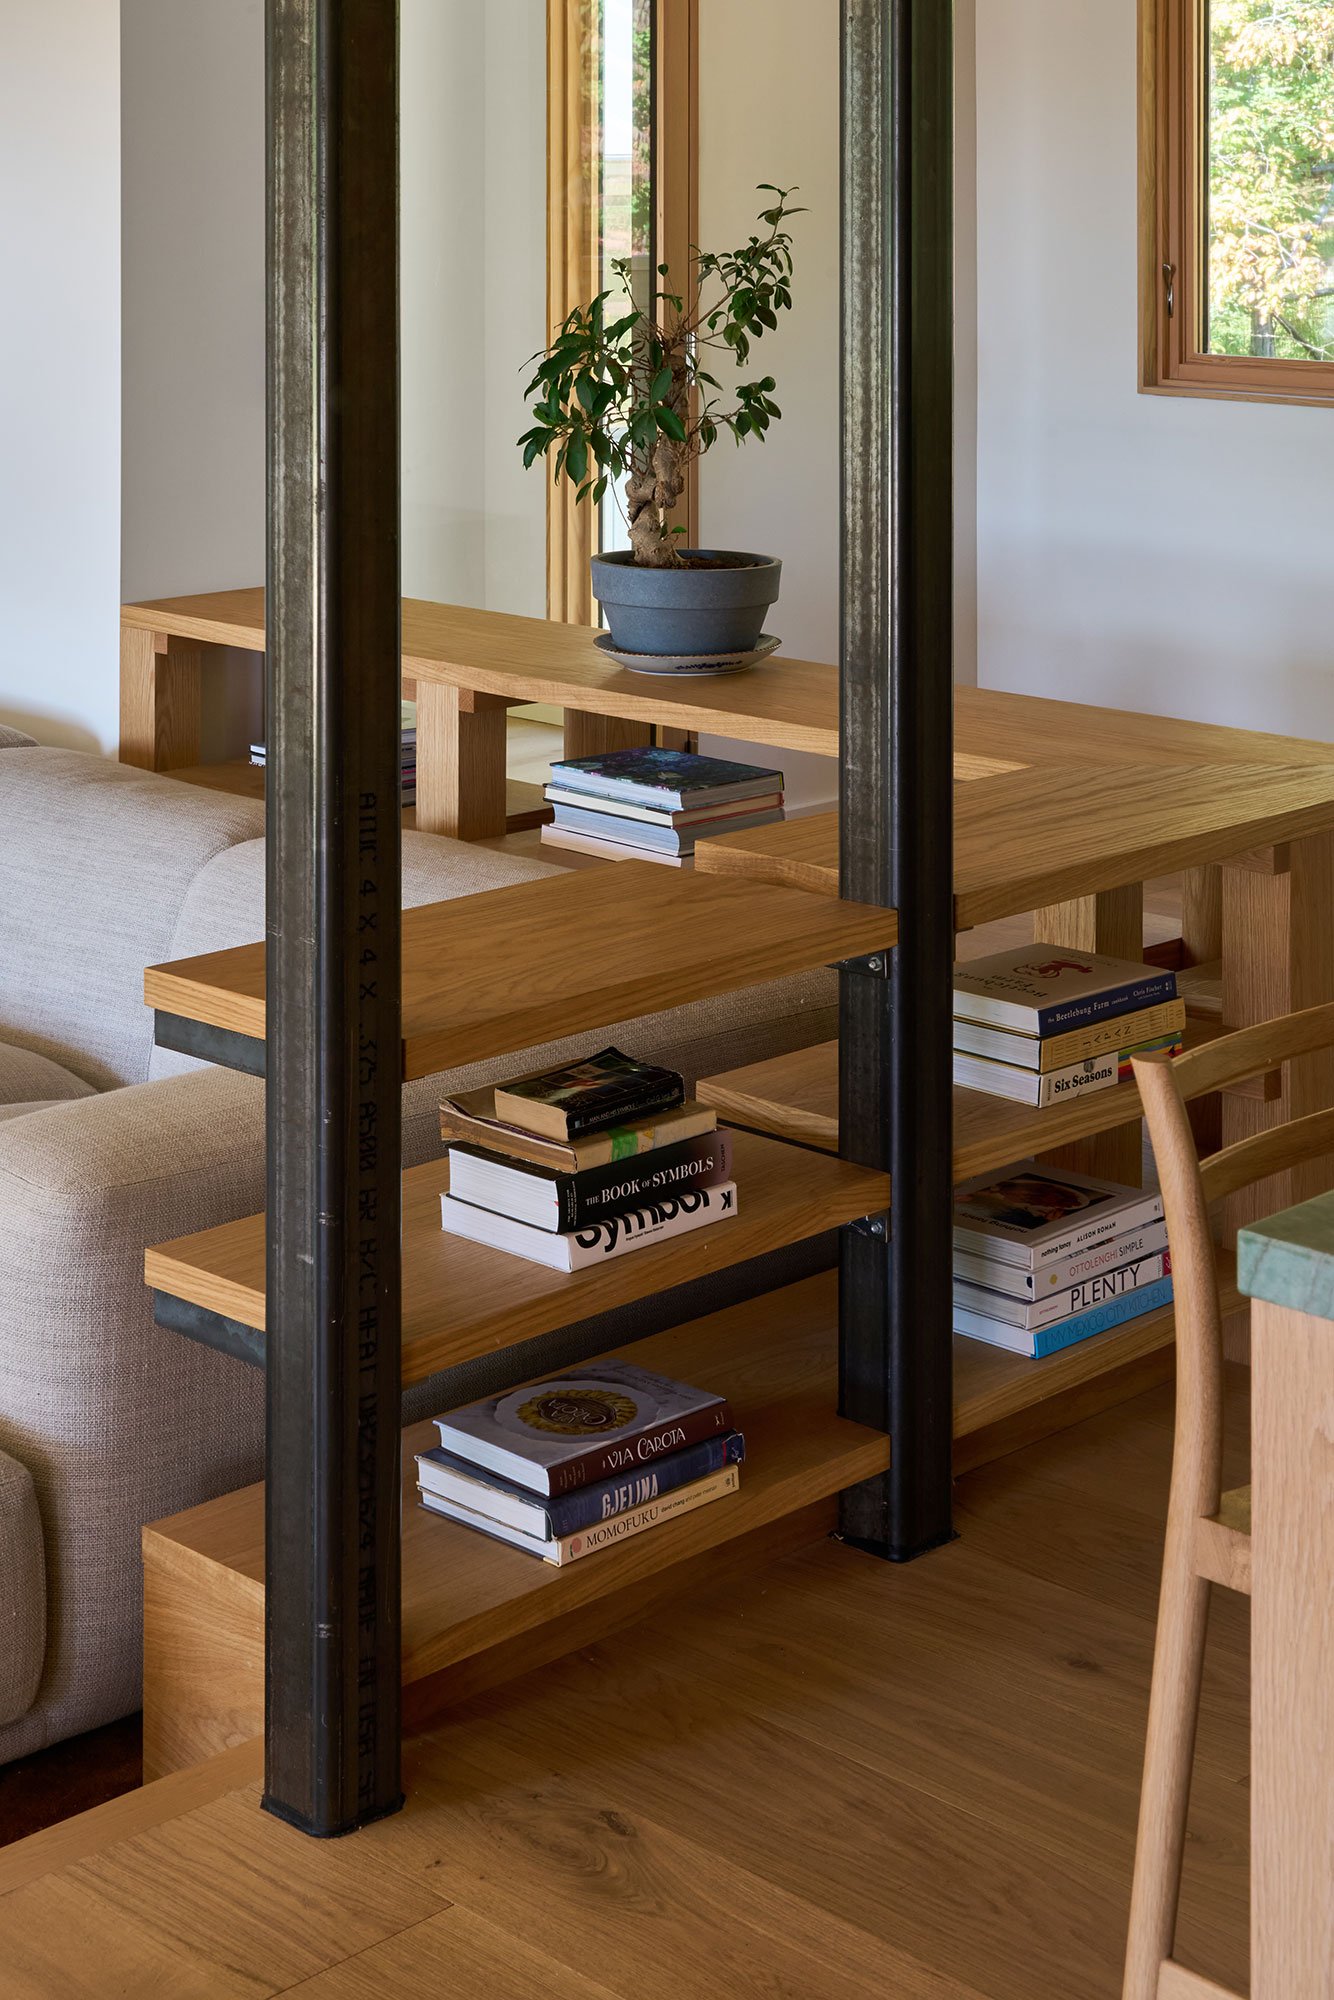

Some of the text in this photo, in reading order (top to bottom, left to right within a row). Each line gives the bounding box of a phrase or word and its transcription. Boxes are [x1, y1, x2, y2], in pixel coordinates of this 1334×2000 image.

[1055, 1005, 1092, 1022] Beetlebung
[1093, 999, 1110, 1011] Farm
[1054, 1078, 1071, 1094] Six
[1072, 1065, 1113, 1088] Seasons
[585, 1194, 600, 1206] THE
[601, 1178, 641, 1204] BOOK
[641, 1179, 651, 1189] OF
[652, 1156, 714, 1188] SYMBOLS
[1040, 1221, 1117, 1258] nothing fancy ALISON ROMAN
[1069, 1238, 1144, 1277] OTTOLENGHI SIMPLE
[1070, 1264, 1141, 1311] PLENTY
[1066, 1311, 1107, 1338] MEXICO
[1107, 1302, 1127, 1324] CITY
[1128, 1286, 1167, 1317] KITCHEN
[607, 1427, 686, 1469] VIA CAROTA
[601, 1473, 659, 1519] GJELINA
[586, 1506, 659, 1548] MOMOFUKU
